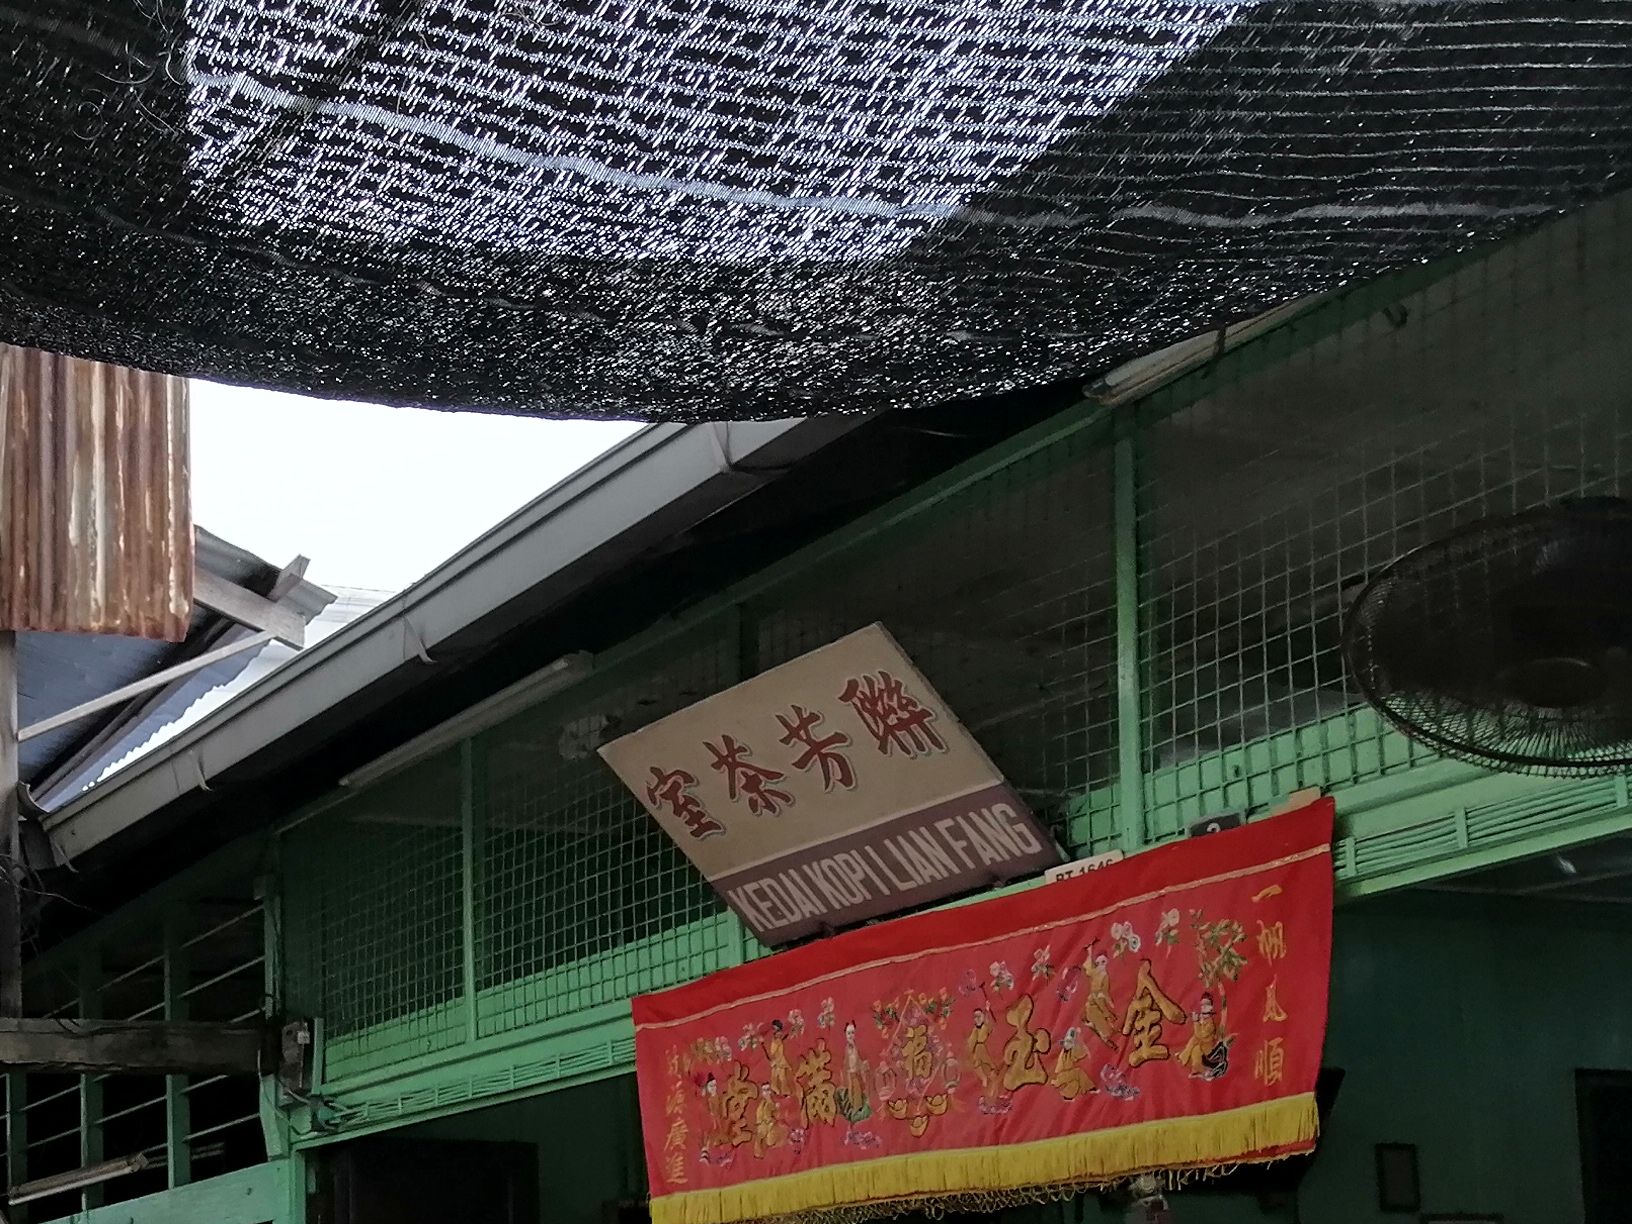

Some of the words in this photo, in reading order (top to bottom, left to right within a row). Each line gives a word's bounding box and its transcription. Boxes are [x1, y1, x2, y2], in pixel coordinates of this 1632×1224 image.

[728, 868, 829, 931] KEDAI
[805, 848, 892, 910] KOPI
[862, 825, 963, 892] LIAN
[932, 798, 1045, 871] FANG
